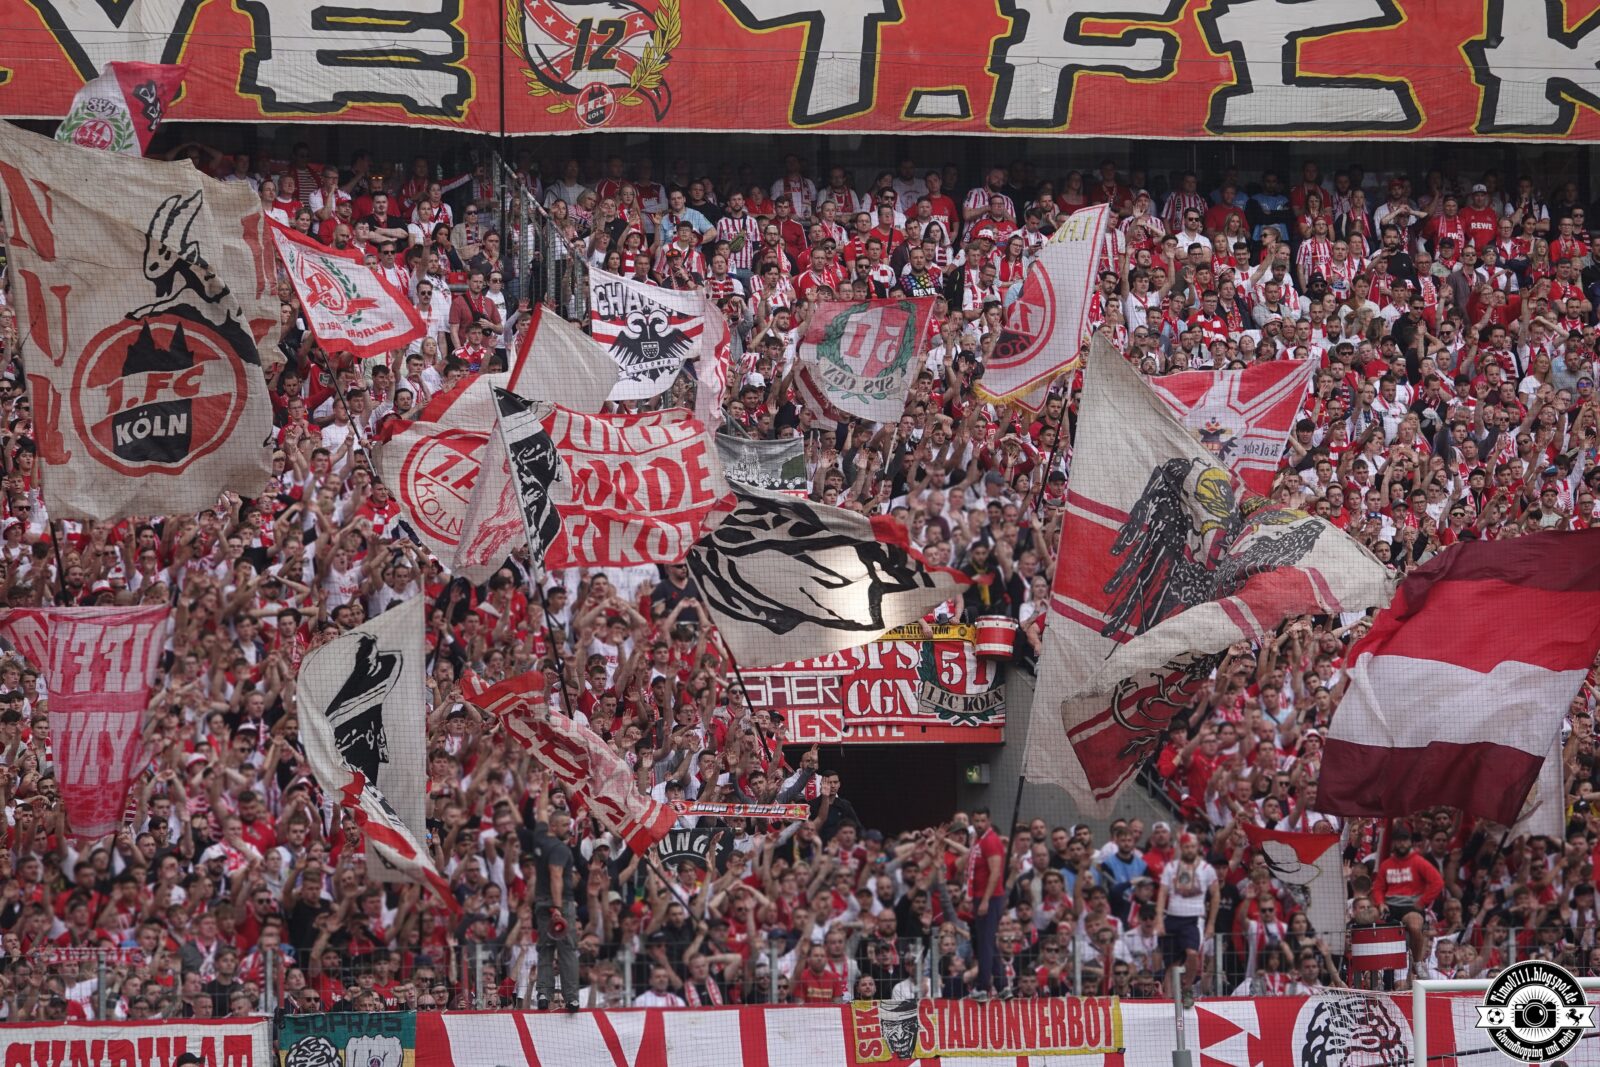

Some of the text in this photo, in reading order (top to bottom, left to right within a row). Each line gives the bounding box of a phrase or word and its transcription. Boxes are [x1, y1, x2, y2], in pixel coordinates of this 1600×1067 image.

[571, 17, 628, 71] 12
[1471, 222, 1494, 230] REWE
[913, 288, 936, 297] REWE
[633, 359, 672, 371] COLONIA
[115, 411, 188, 447] KÖLN
[414, 482, 464, 536] KÖLN
[847, 678, 922, 717] CGN
[941, 689, 959, 709] FC
[963, 685, 1004, 712] KÖLN
[918, 996, 1114, 1051] STADIONVERBOT
